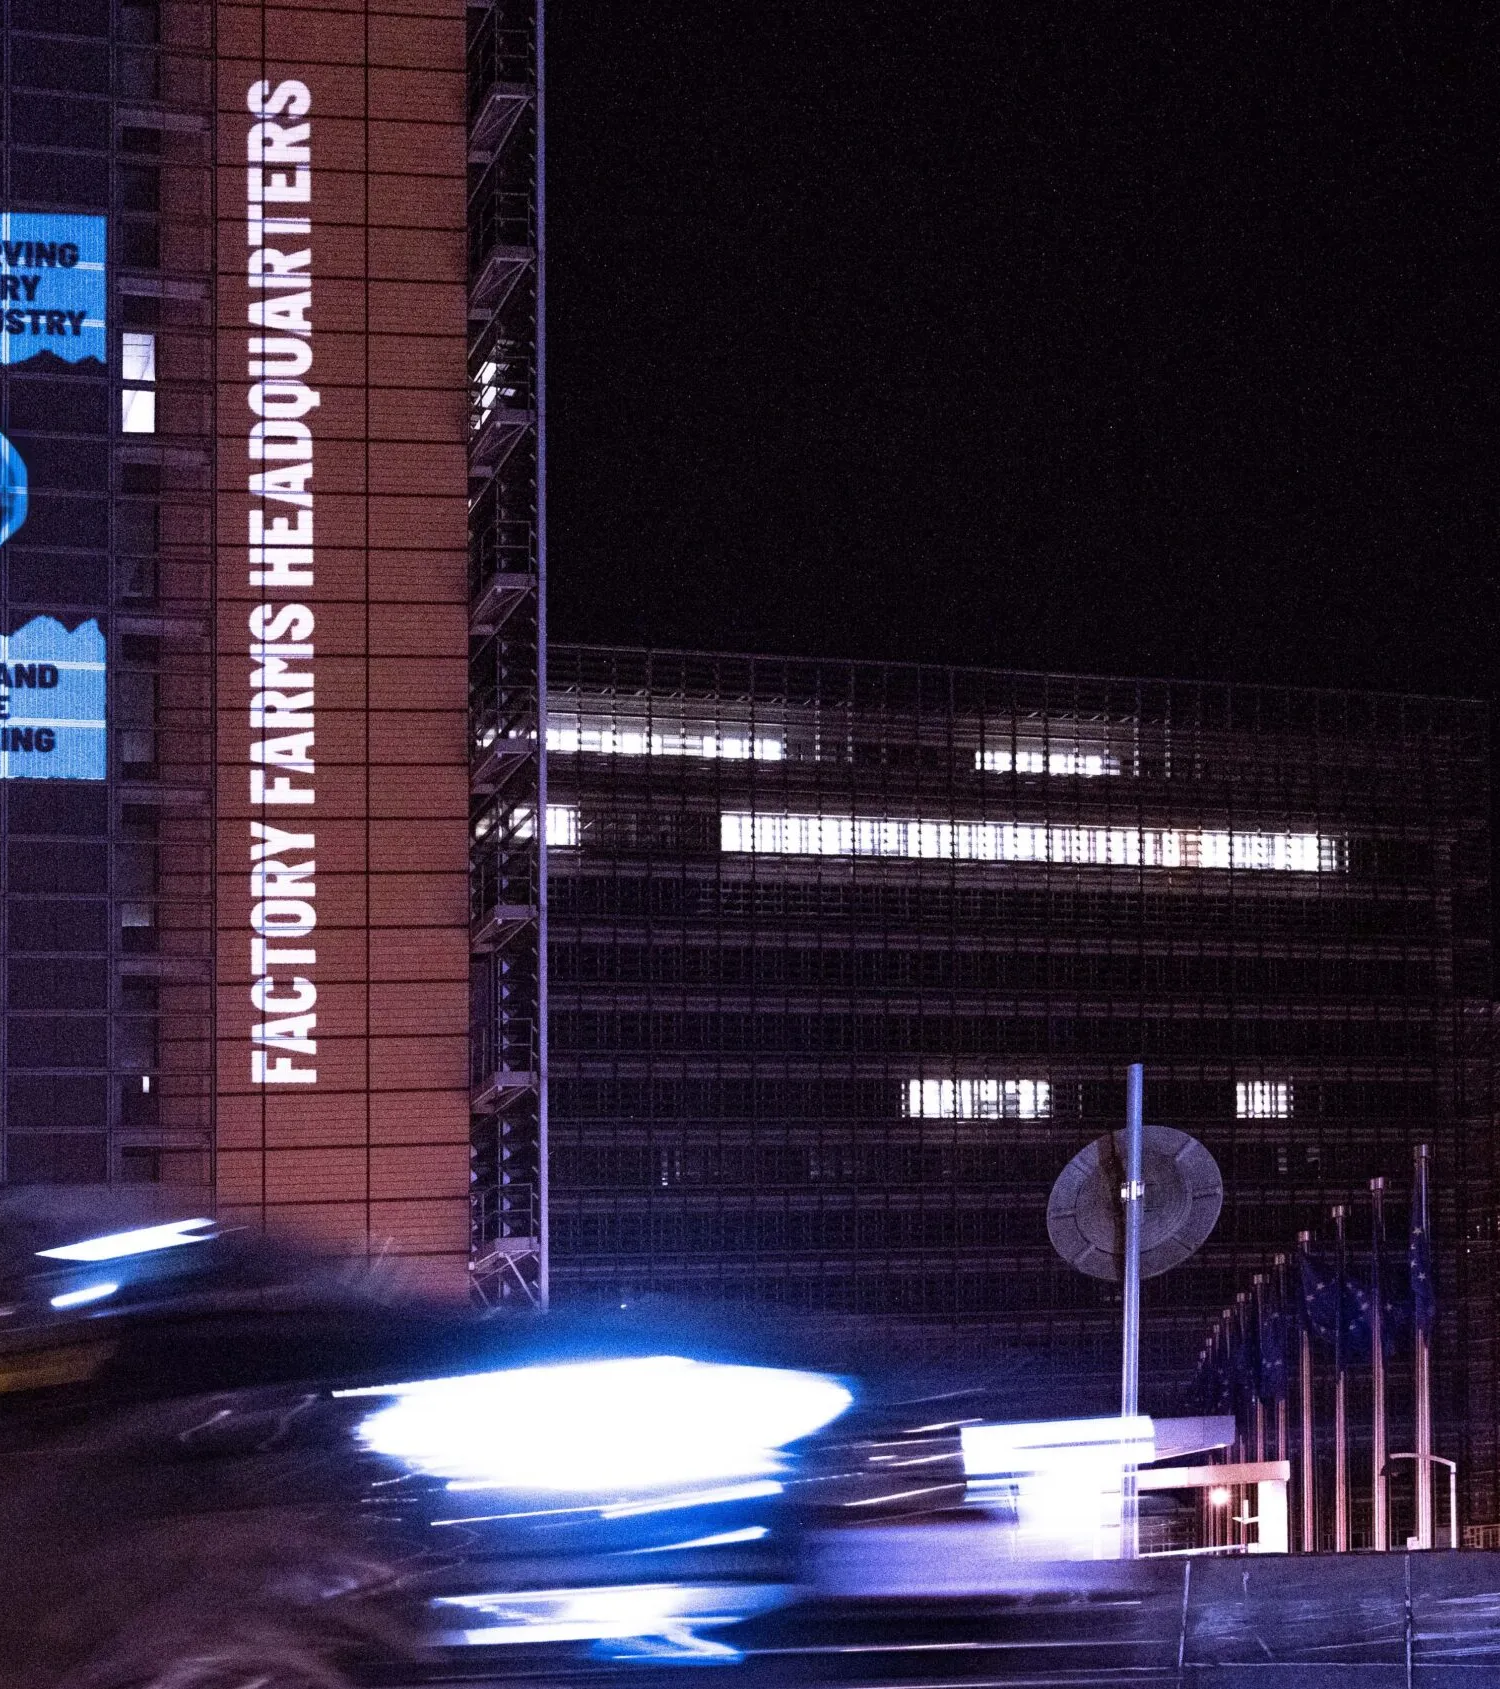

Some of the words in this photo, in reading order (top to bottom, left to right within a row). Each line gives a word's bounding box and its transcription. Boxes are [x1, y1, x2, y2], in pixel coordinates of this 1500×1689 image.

[247, 79, 320, 587] HEADQUARTERS
[249, 603, 315, 804] FARMS
[250, 821, 317, 1084] FACTORY
